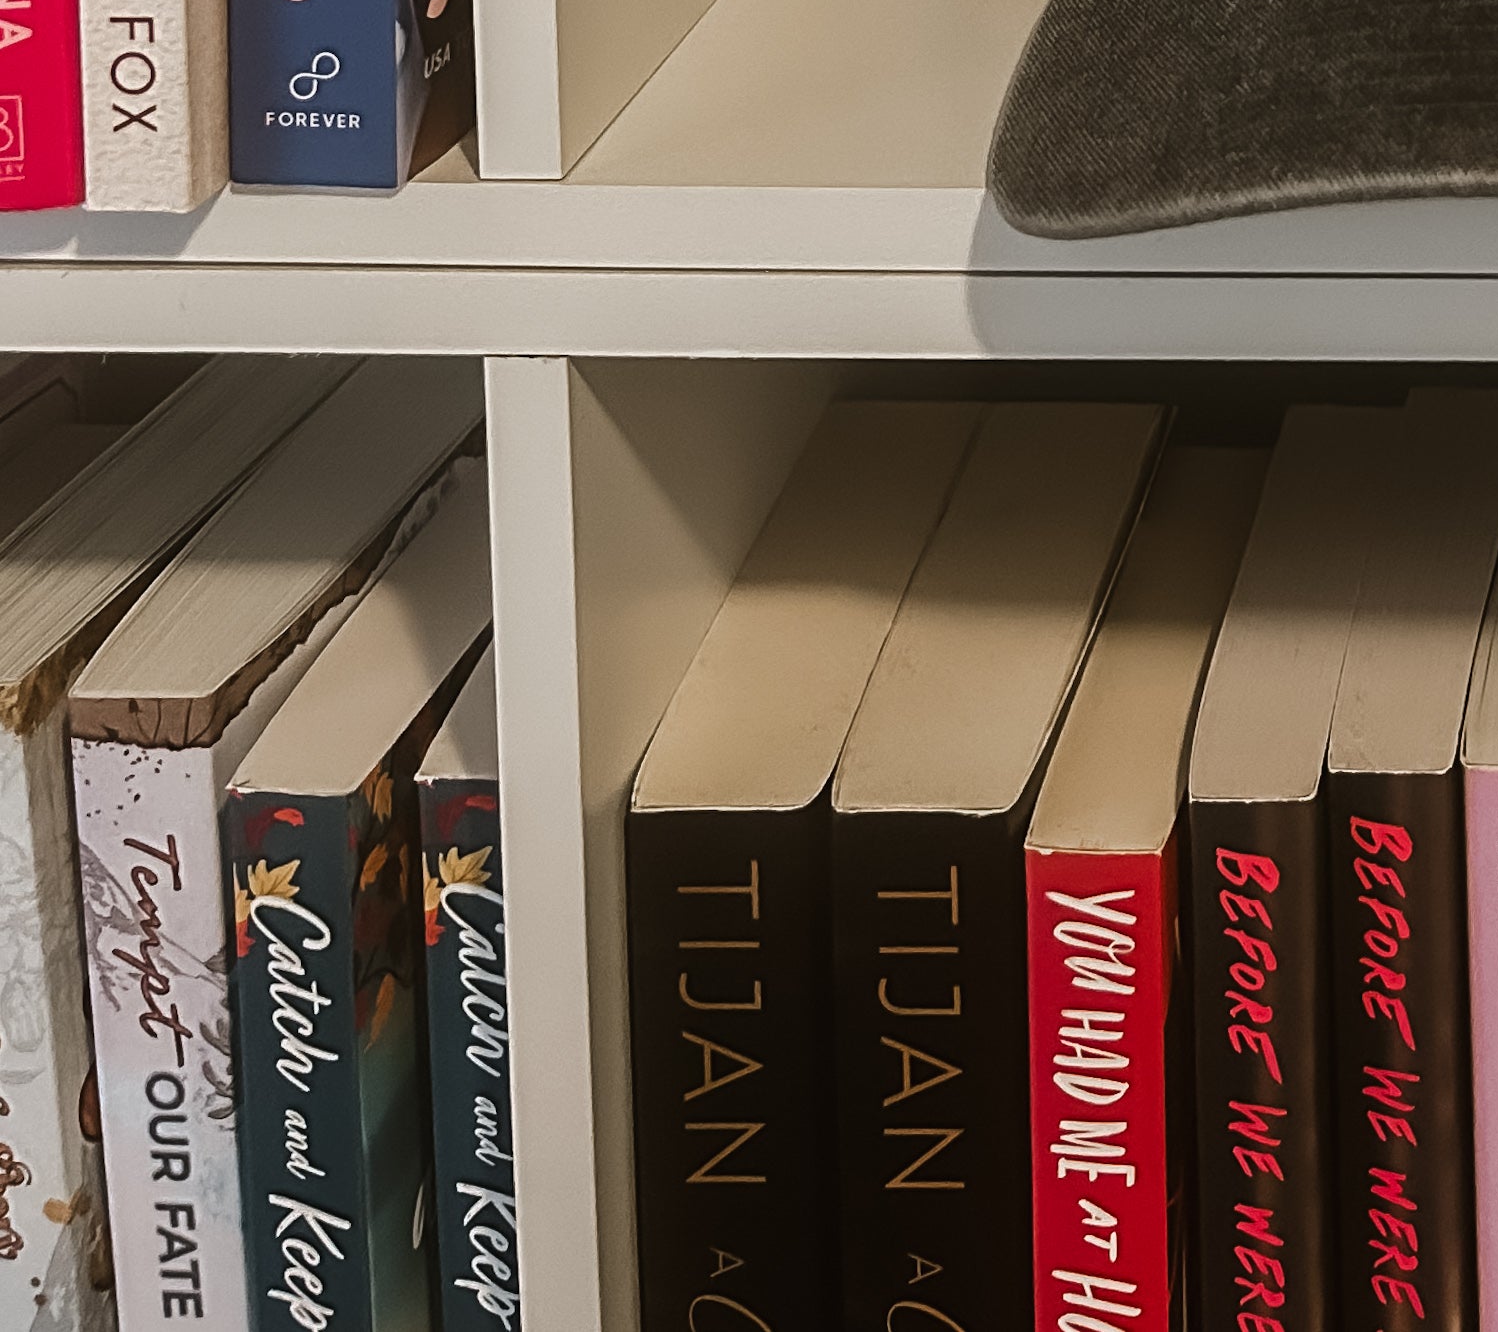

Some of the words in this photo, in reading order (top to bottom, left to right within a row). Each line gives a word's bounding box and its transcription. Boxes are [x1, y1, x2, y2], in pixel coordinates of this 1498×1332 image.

[109, 16, 158, 132] FOX
[265, 111, 361, 130] FOREVER
[112, 834, 193, 1068] Tempt
[1215, 847, 1283, 1085] BEFORE
[1350, 816, 1416, 1051] BEFORE
[250, 896, 339, 1094] Catch
[677, 860, 766, 1184] TIJAN
[877, 865, 965, 1189] TIJAN
[1053, 1009, 1130, 1106] HAD
[1361, 1065, 1420, 1147] WE
[145, 1072, 193, 1182] OUR
[284, 1108, 325, 1180] and
[474, 1096, 512, 1167] and
[1050, 1121, 1136, 1187] ME
[1228, 1100, 1288, 1181] WE
[155, 1202, 204, 1320] FATE
[268, 1194, 351, 1332] Keep
[1078, 1199, 1118, 1262] AT
[1368, 1167, 1425, 1319] WERE
